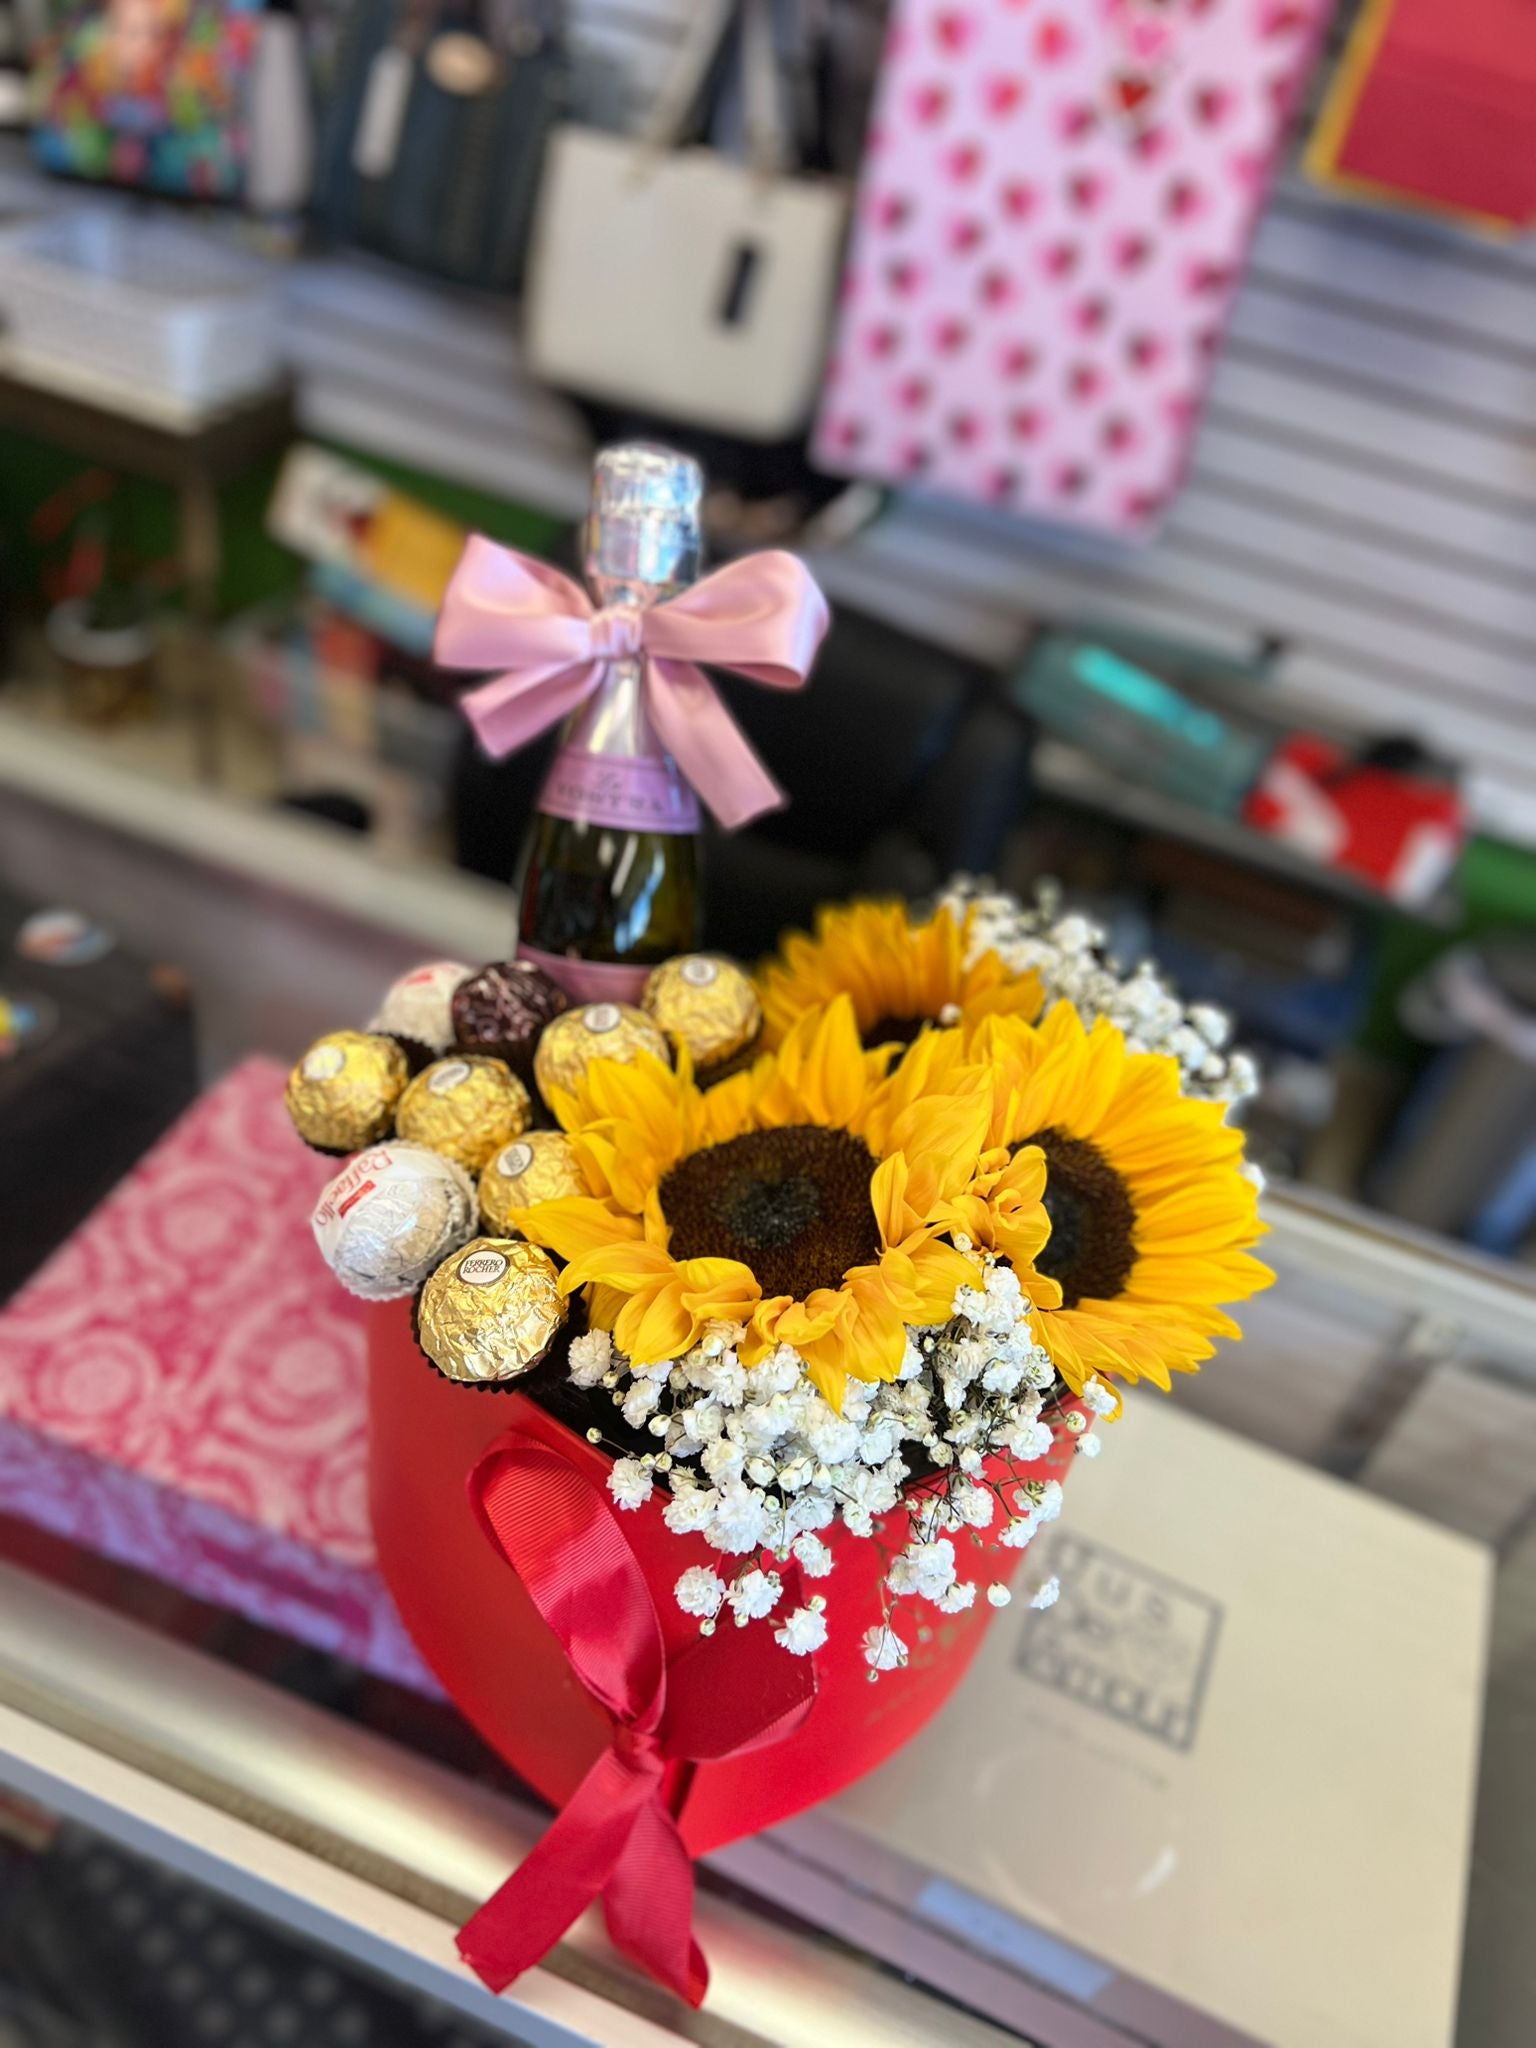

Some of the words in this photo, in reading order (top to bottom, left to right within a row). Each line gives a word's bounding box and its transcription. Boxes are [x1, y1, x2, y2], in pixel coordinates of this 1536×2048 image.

[315, 1151, 392, 1226] Raffaello
[465, 1259, 503, 1267] FERRERO
[462, 1265, 500, 1274] ROCHER
